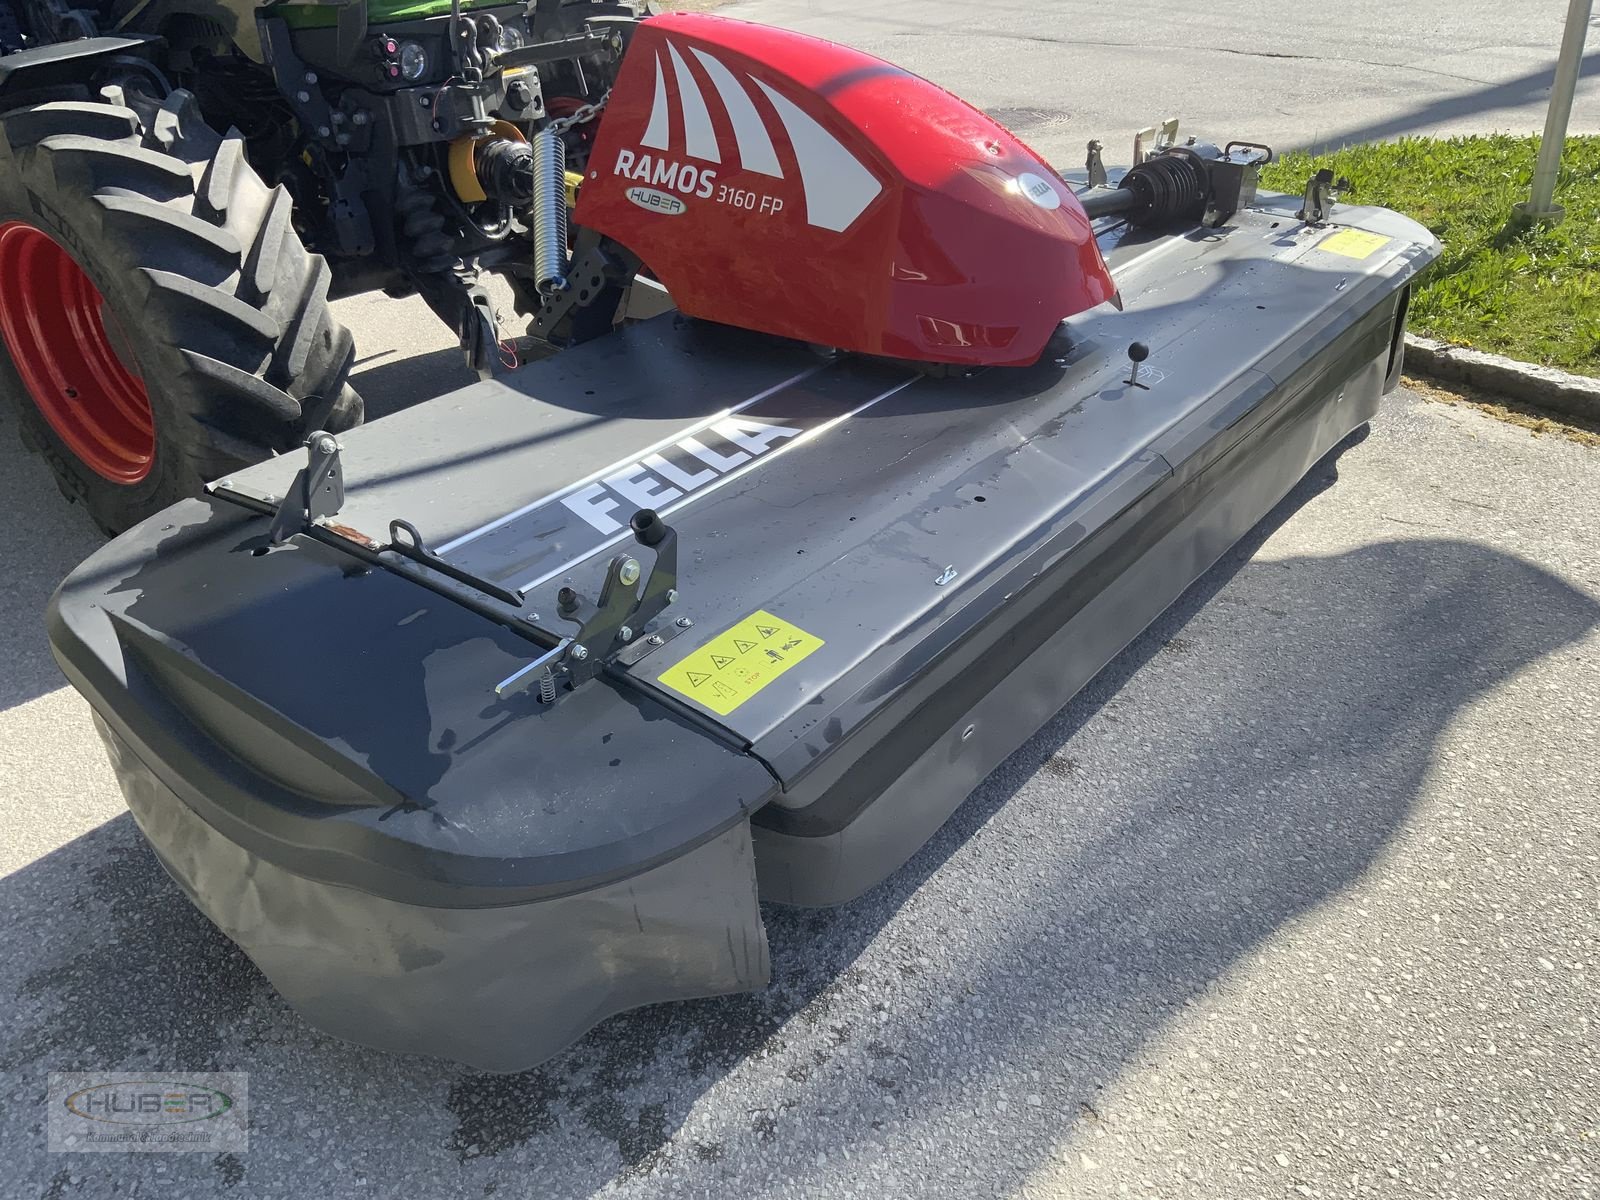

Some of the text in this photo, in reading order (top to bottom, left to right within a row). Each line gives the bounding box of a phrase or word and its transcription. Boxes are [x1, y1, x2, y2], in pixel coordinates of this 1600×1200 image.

[614, 149, 783, 215] RAMOS 3160 FP
[630, 188, 681, 213] HUBER
[560, 418, 804, 536] FELLA
[744, 671, 761, 685] STOP
